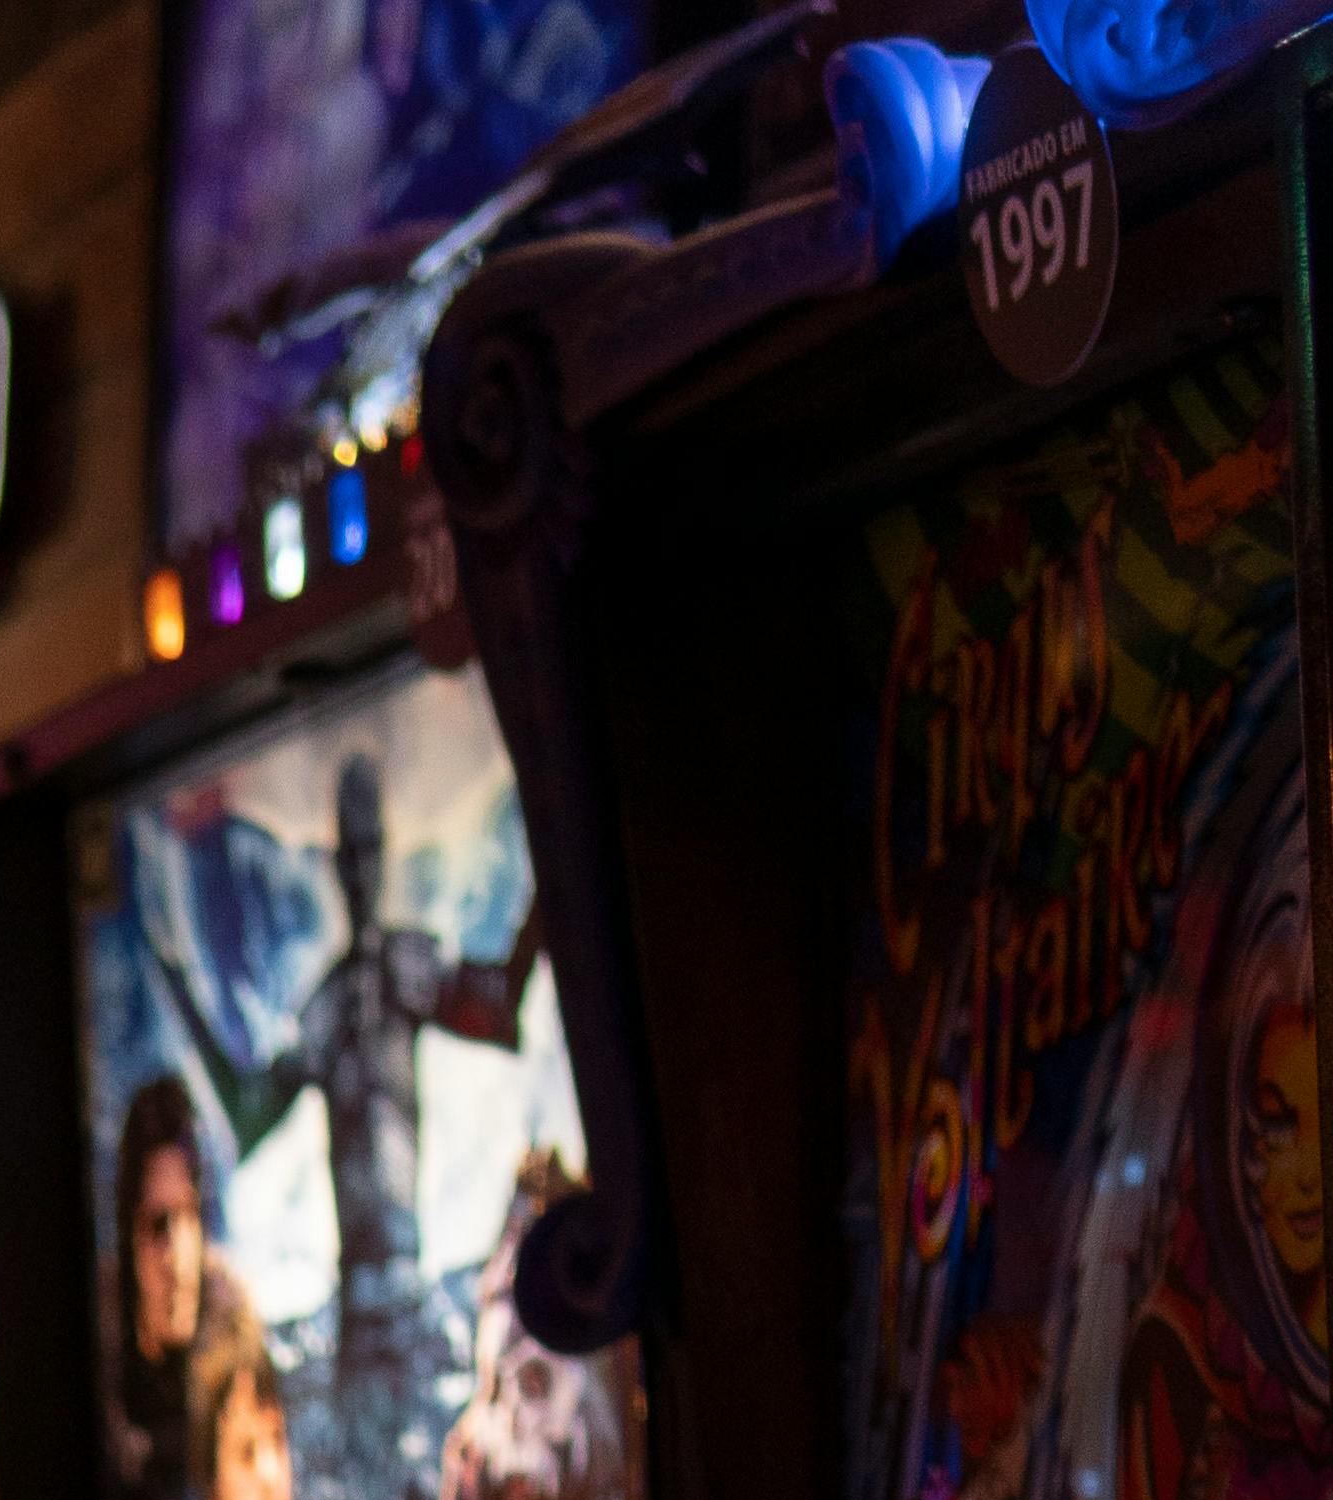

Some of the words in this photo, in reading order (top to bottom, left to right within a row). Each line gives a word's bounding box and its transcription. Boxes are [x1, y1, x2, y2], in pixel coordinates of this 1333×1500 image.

[964, 130, 1058, 201] FABRICADO
[1059, 115, 1088, 156] EM
[970, 160, 1094, 311] 1997
